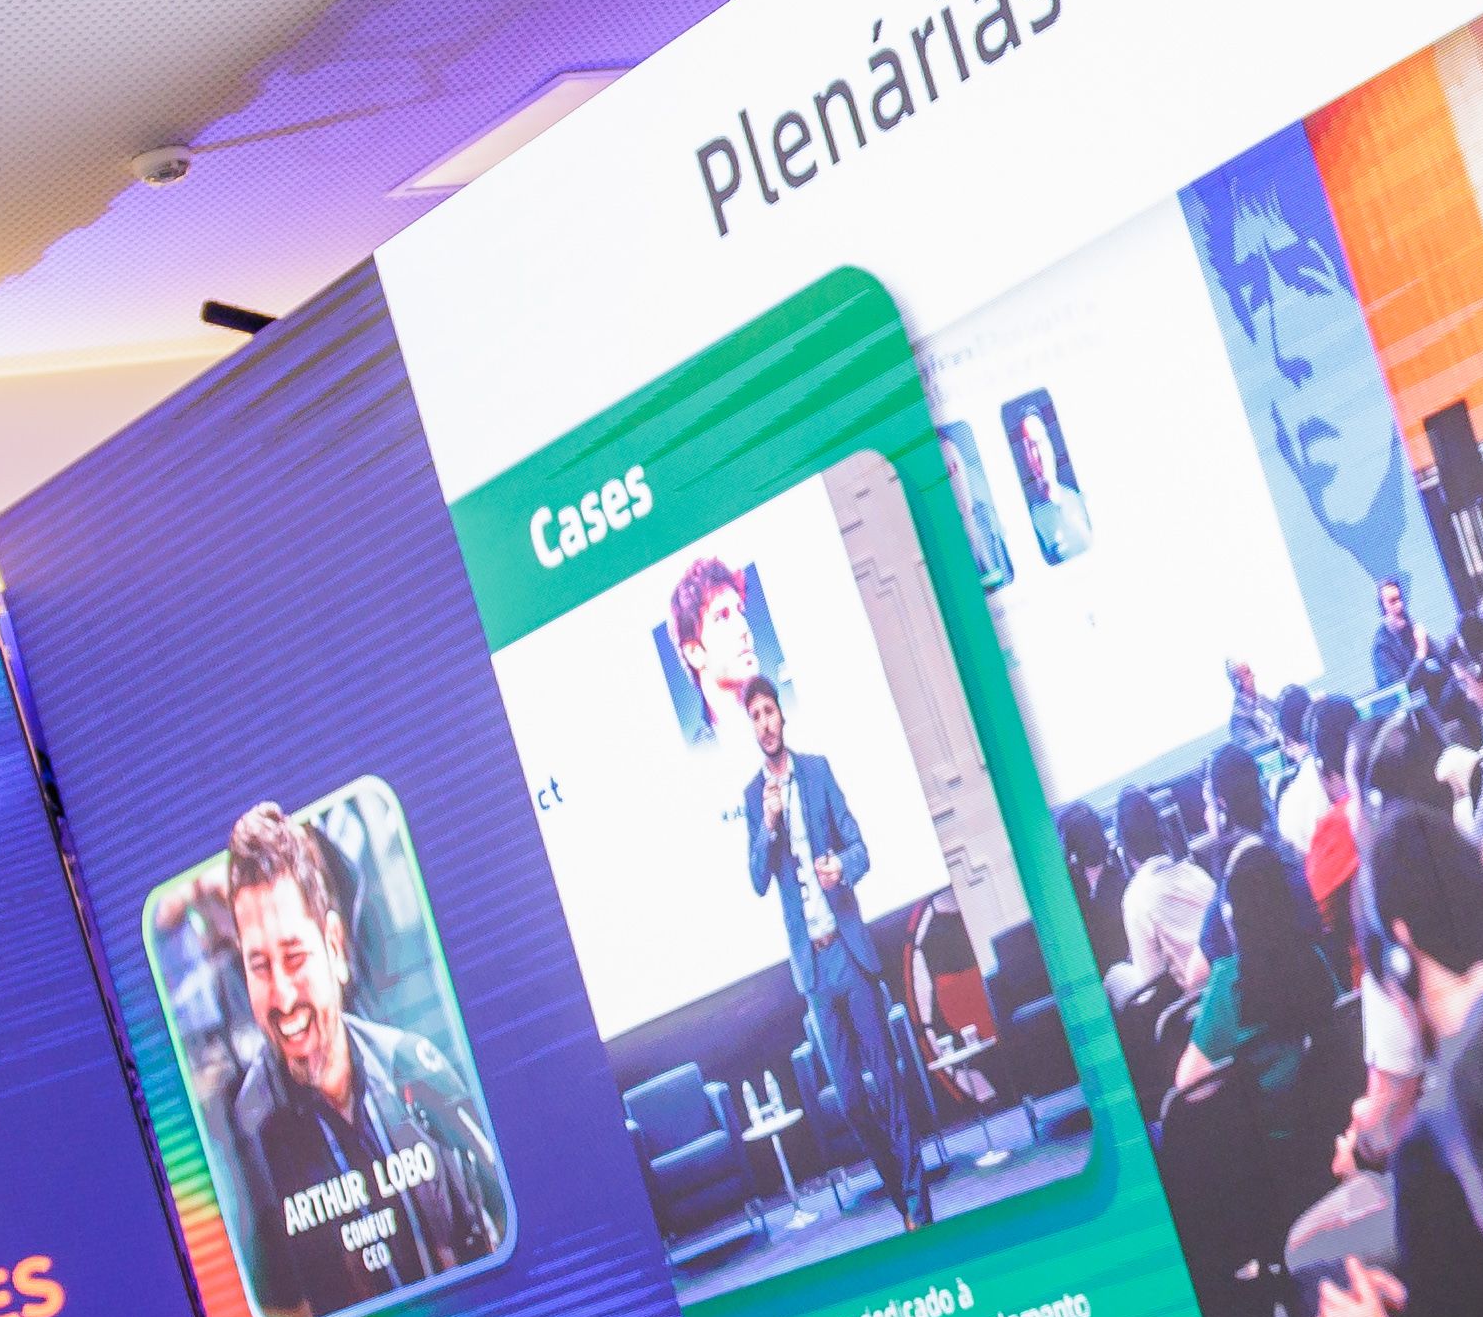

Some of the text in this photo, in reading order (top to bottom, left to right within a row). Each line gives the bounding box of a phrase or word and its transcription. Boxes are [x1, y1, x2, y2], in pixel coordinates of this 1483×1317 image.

[530, 465, 653, 568] Cases
[284, 1142, 436, 1236] ARTHUR LOBO
[341, 1207, 397, 1252] CONFUT
[362, 1241, 391, 1272] CEO
